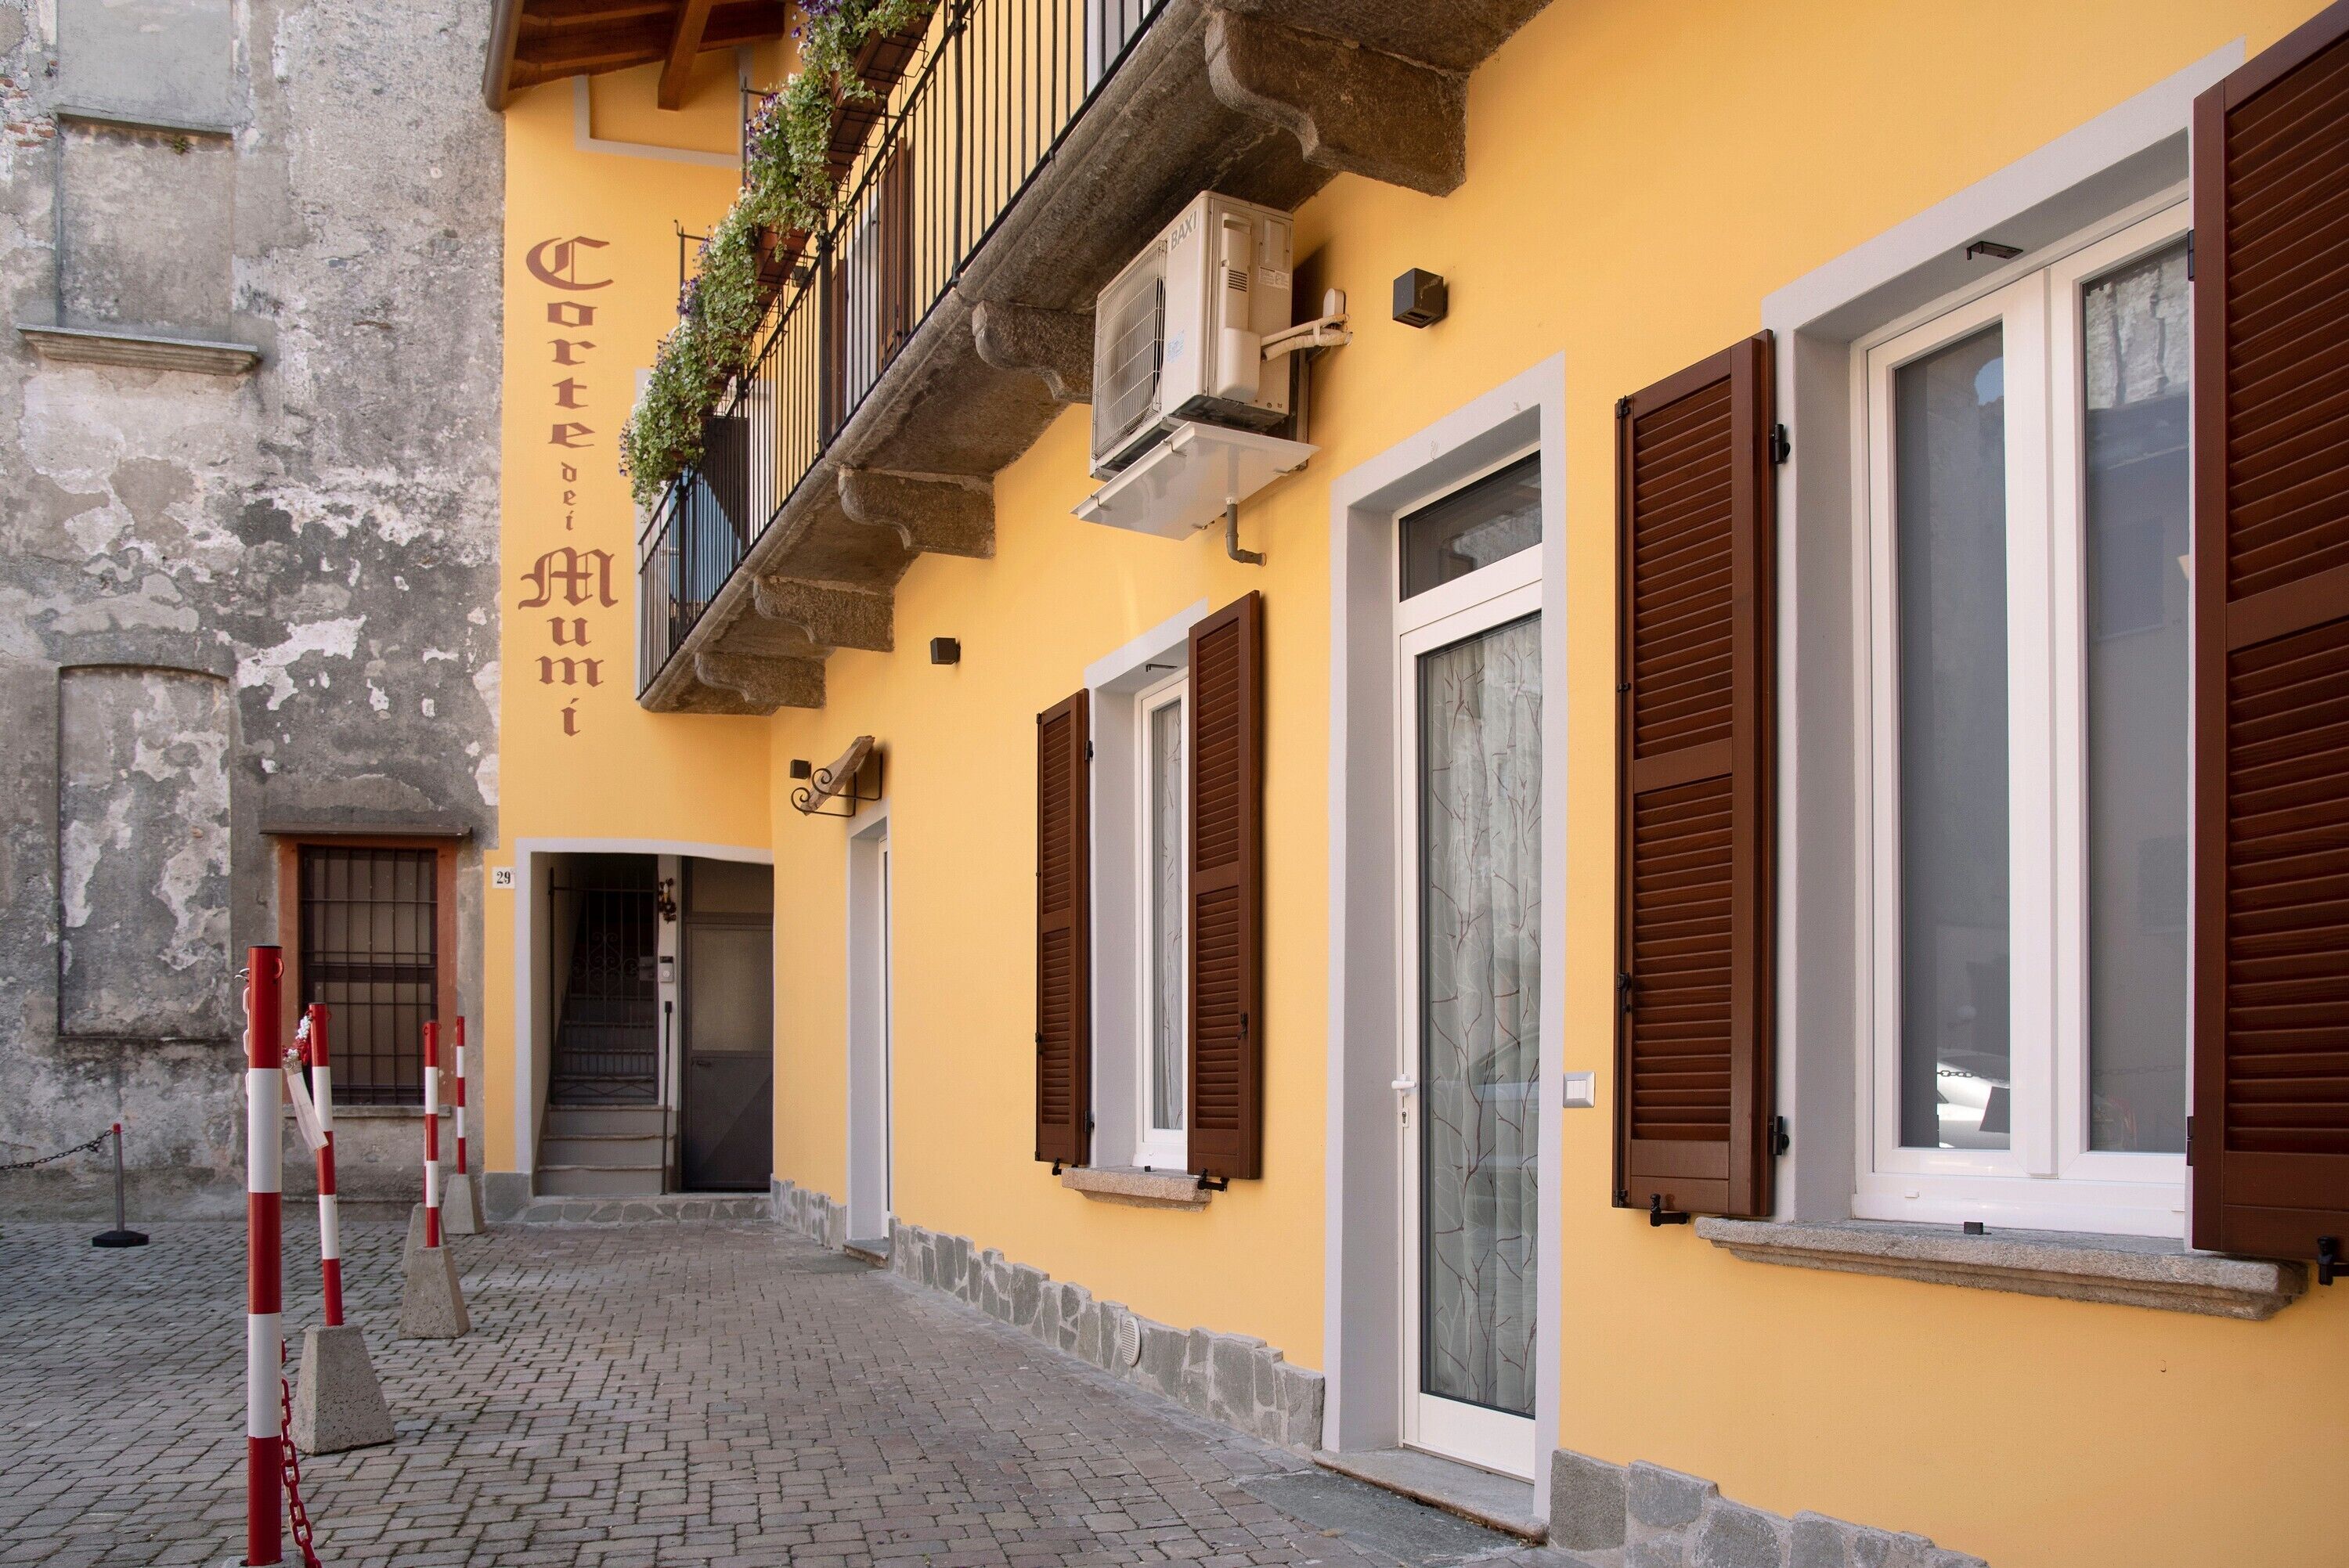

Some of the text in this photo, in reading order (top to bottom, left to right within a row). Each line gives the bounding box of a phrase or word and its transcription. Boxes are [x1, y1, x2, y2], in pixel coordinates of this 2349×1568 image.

[1171, 210, 1197, 251] BAXI
[518, 235, 619, 737] Corte dei Mumi
[496, 871, 511, 885] 29
